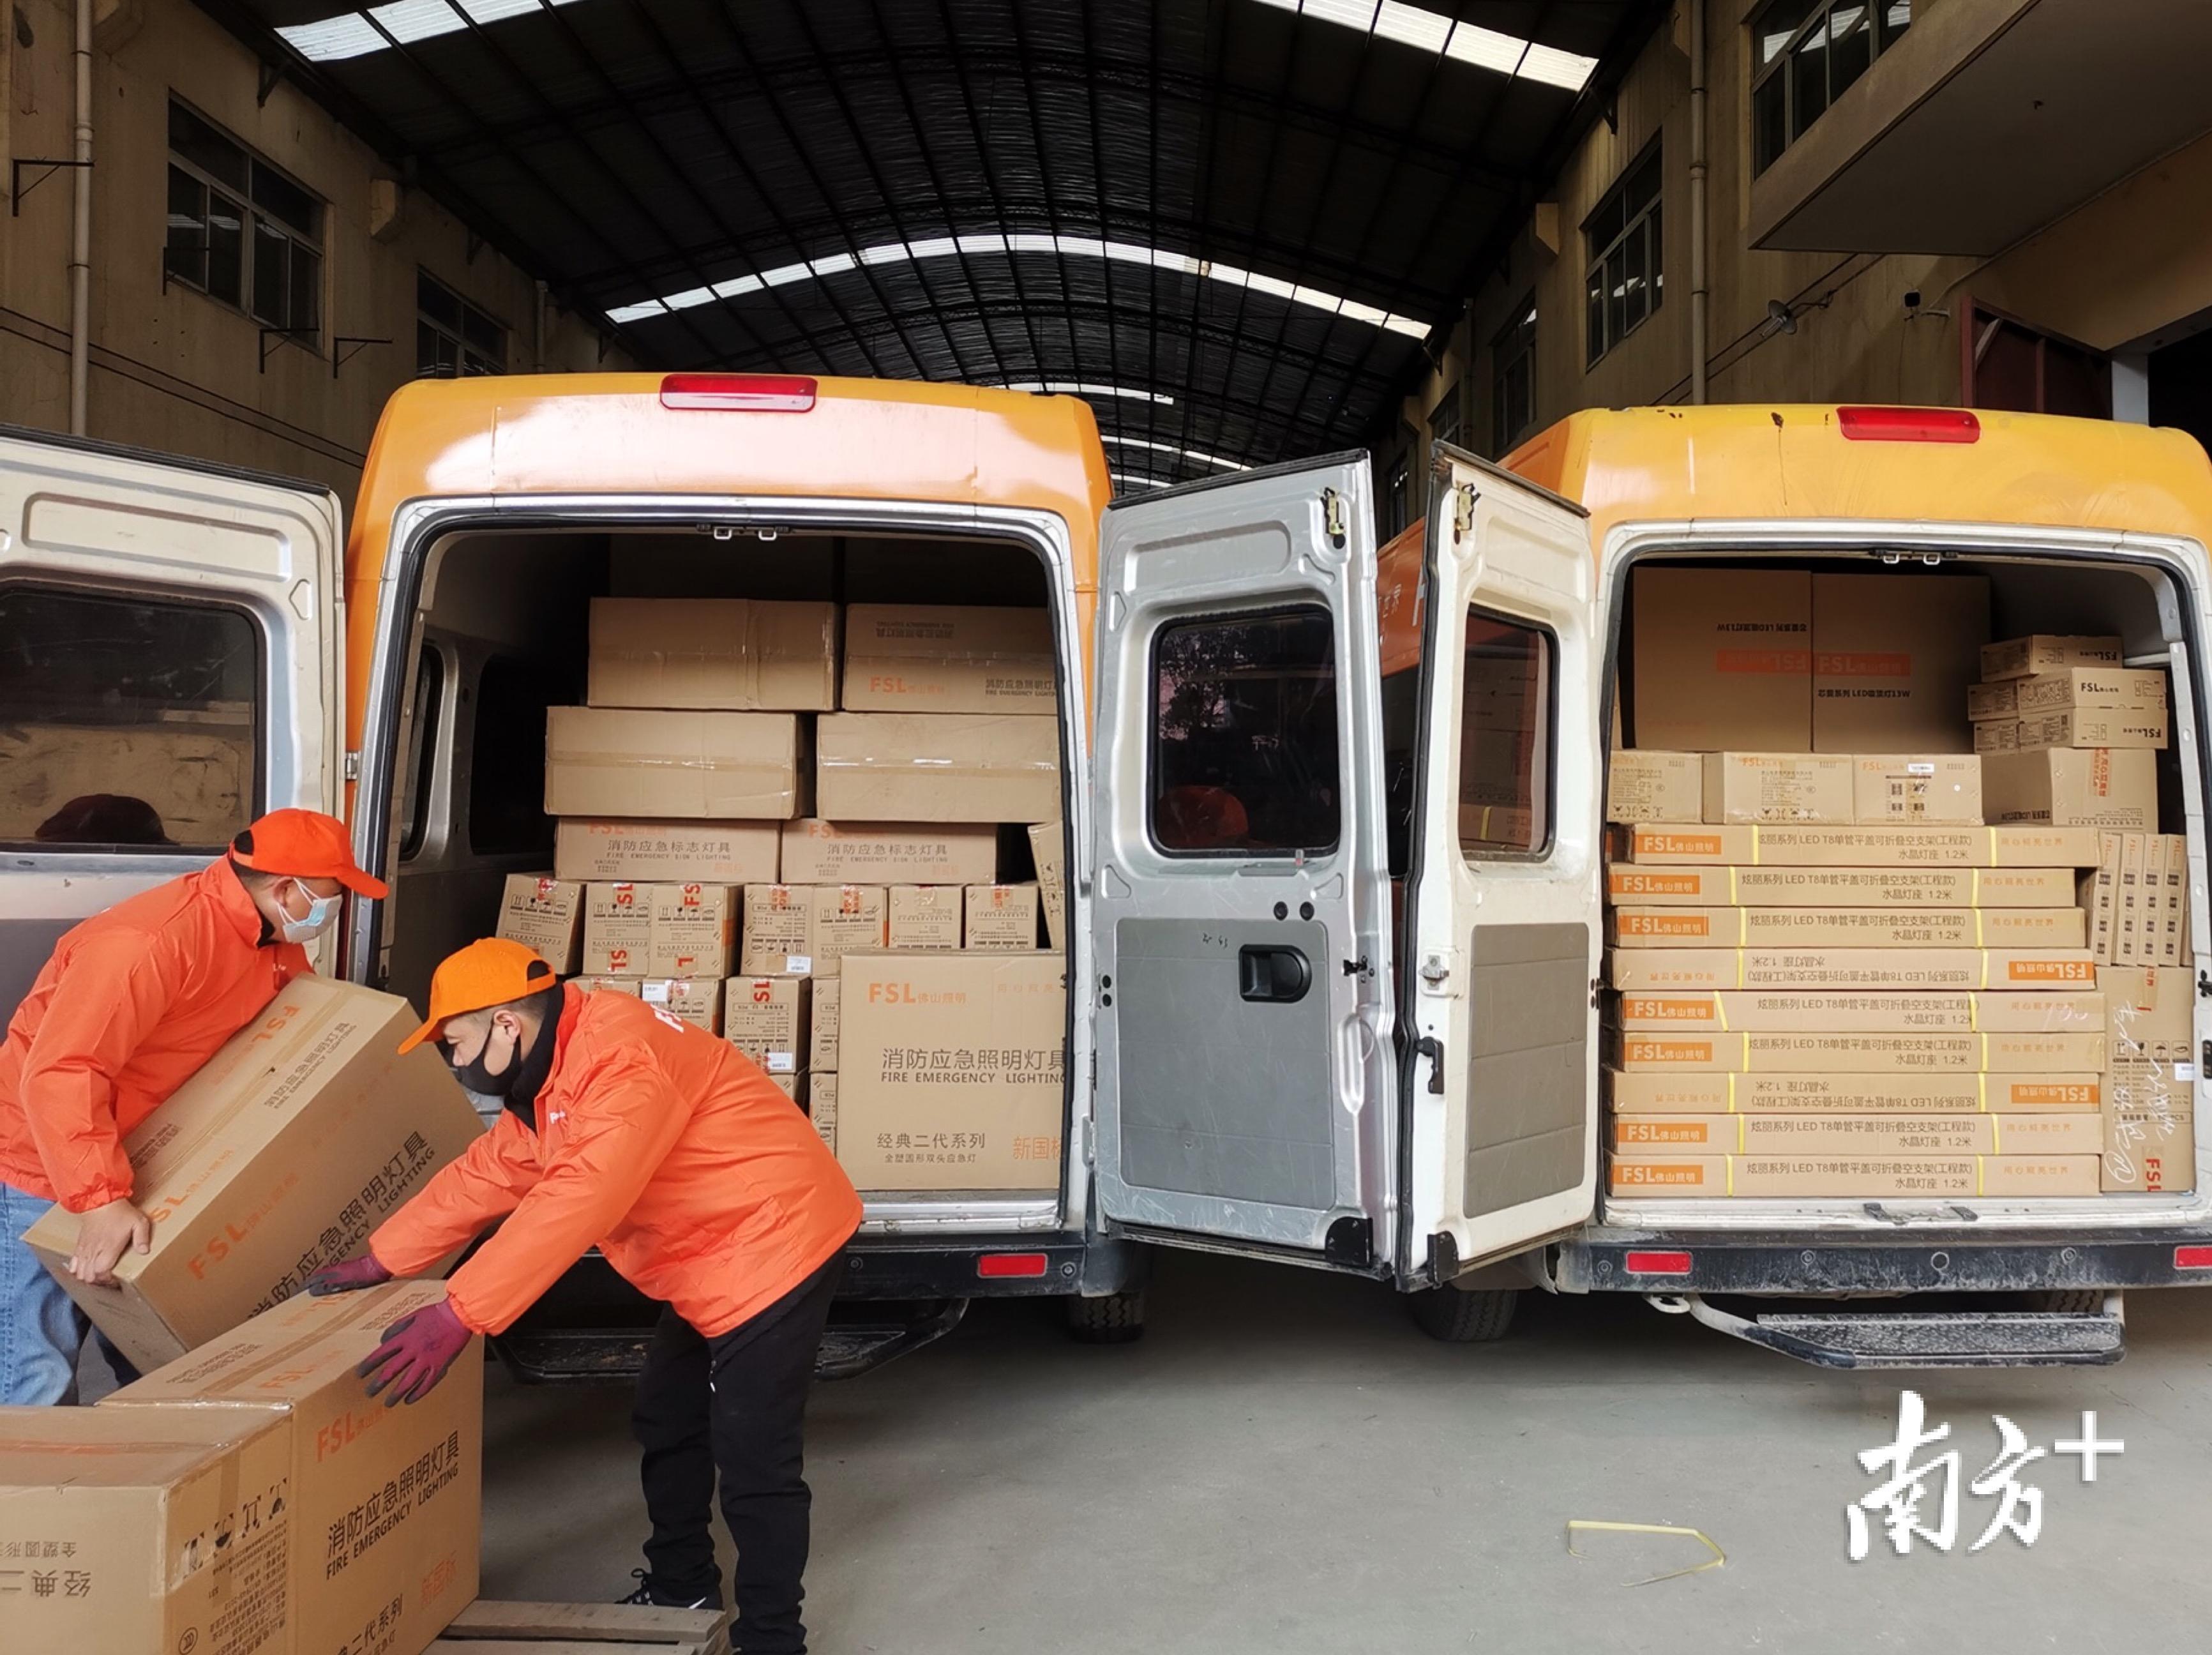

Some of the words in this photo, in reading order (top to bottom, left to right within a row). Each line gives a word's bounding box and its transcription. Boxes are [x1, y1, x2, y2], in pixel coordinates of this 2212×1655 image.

[870, 677, 906, 693] FSL
[986, 679, 1057, 690] 消防应急照明灯
[2081, 683, 2098, 693] FSL
[1862, 761, 1881, 771] FSL
[588, 822, 623, 835] FSL
[608, 840, 730, 852] 消防应急标志灯具
[1644, 836, 1676, 852] FSL
[1800, 835, 1819, 845] LED
[827, 843, 947, 855] 消防应急标志灯具
[1899, 849, 1939, 859] 水晶灯座
[1945, 850, 1968, 859] 1.2米
[1623, 877, 1655, 891] FSL
[1786, 875, 1805, 884] LED
[1883, 889, 1922, 900] 水晶灯座
[1929, 890, 1952, 900] 1.2米
[1631, 918, 1663, 933] FSL
[1794, 916, 1813, 925] LED
[1892, 930, 1932, 941] 水晶灯座
[1939, 930, 1962, 940] 1.2米
[1752, 956, 1777, 967] 1.2米
[1905, 971, 1925, 981] LED
[2057, 964, 2087, 979] FSL
[869, 983, 915, 1004] FSL
[918, 993, 967, 1004] 佛山照明
[1634, 1002, 1667, 1017] FSL
[1802, 999, 1823, 1009] LED
[252, 1006, 299, 1043] FSL
[1904, 1014, 1945, 1025] 水晶灯座
[1794, 1039, 1813, 1049] LED
[1633, 1044, 1665, 1059] FSL
[882, 1048, 1065, 1070] 消防应急照明灯具
[1895, 1054, 1937, 1066] 水晶灯座
[1943, 1055, 1968, 1065] 1.2米
[881, 1072, 908, 1082] FIRE
[915, 1073, 995, 1083] EMERGENCY
[1756, 1080, 1781, 1092] 1.2米
[2059, 1087, 2089, 1101] FSL
[1911, 1097, 1931, 1107] LED
[1627, 1125, 1660, 1140] FSL
[1796, 1122, 1817, 1131] LED
[877, 1133, 985, 1149] 经典二代系列
[1899, 1137, 1941, 1148] 水晶灯座
[1947, 1138, 1971, 1147] 1.2米
[1622, 1167, 1655, 1182] FSL
[1793, 1163, 1813, 1174] LED
[378, 1147, 435, 1213] LIGHTING
[1895, 1178, 1937, 1189] 水晶灯座
[1943, 1179, 1968, 1189] 1.2米
[151, 1191, 185, 1224] SL
[188, 1223, 248, 1280] FSL
[317, 1411, 358, 1463] FSL
[327, 1430, 459, 1559] 消防应急照明灯具
[326, 1552, 349, 1580] FIRE
[353, 1500, 412, 1559] EMERGENCY
[418, 1462, 459, 1507] LIGHTING
[0, 1541, 77, 1558] 全塑圆形
